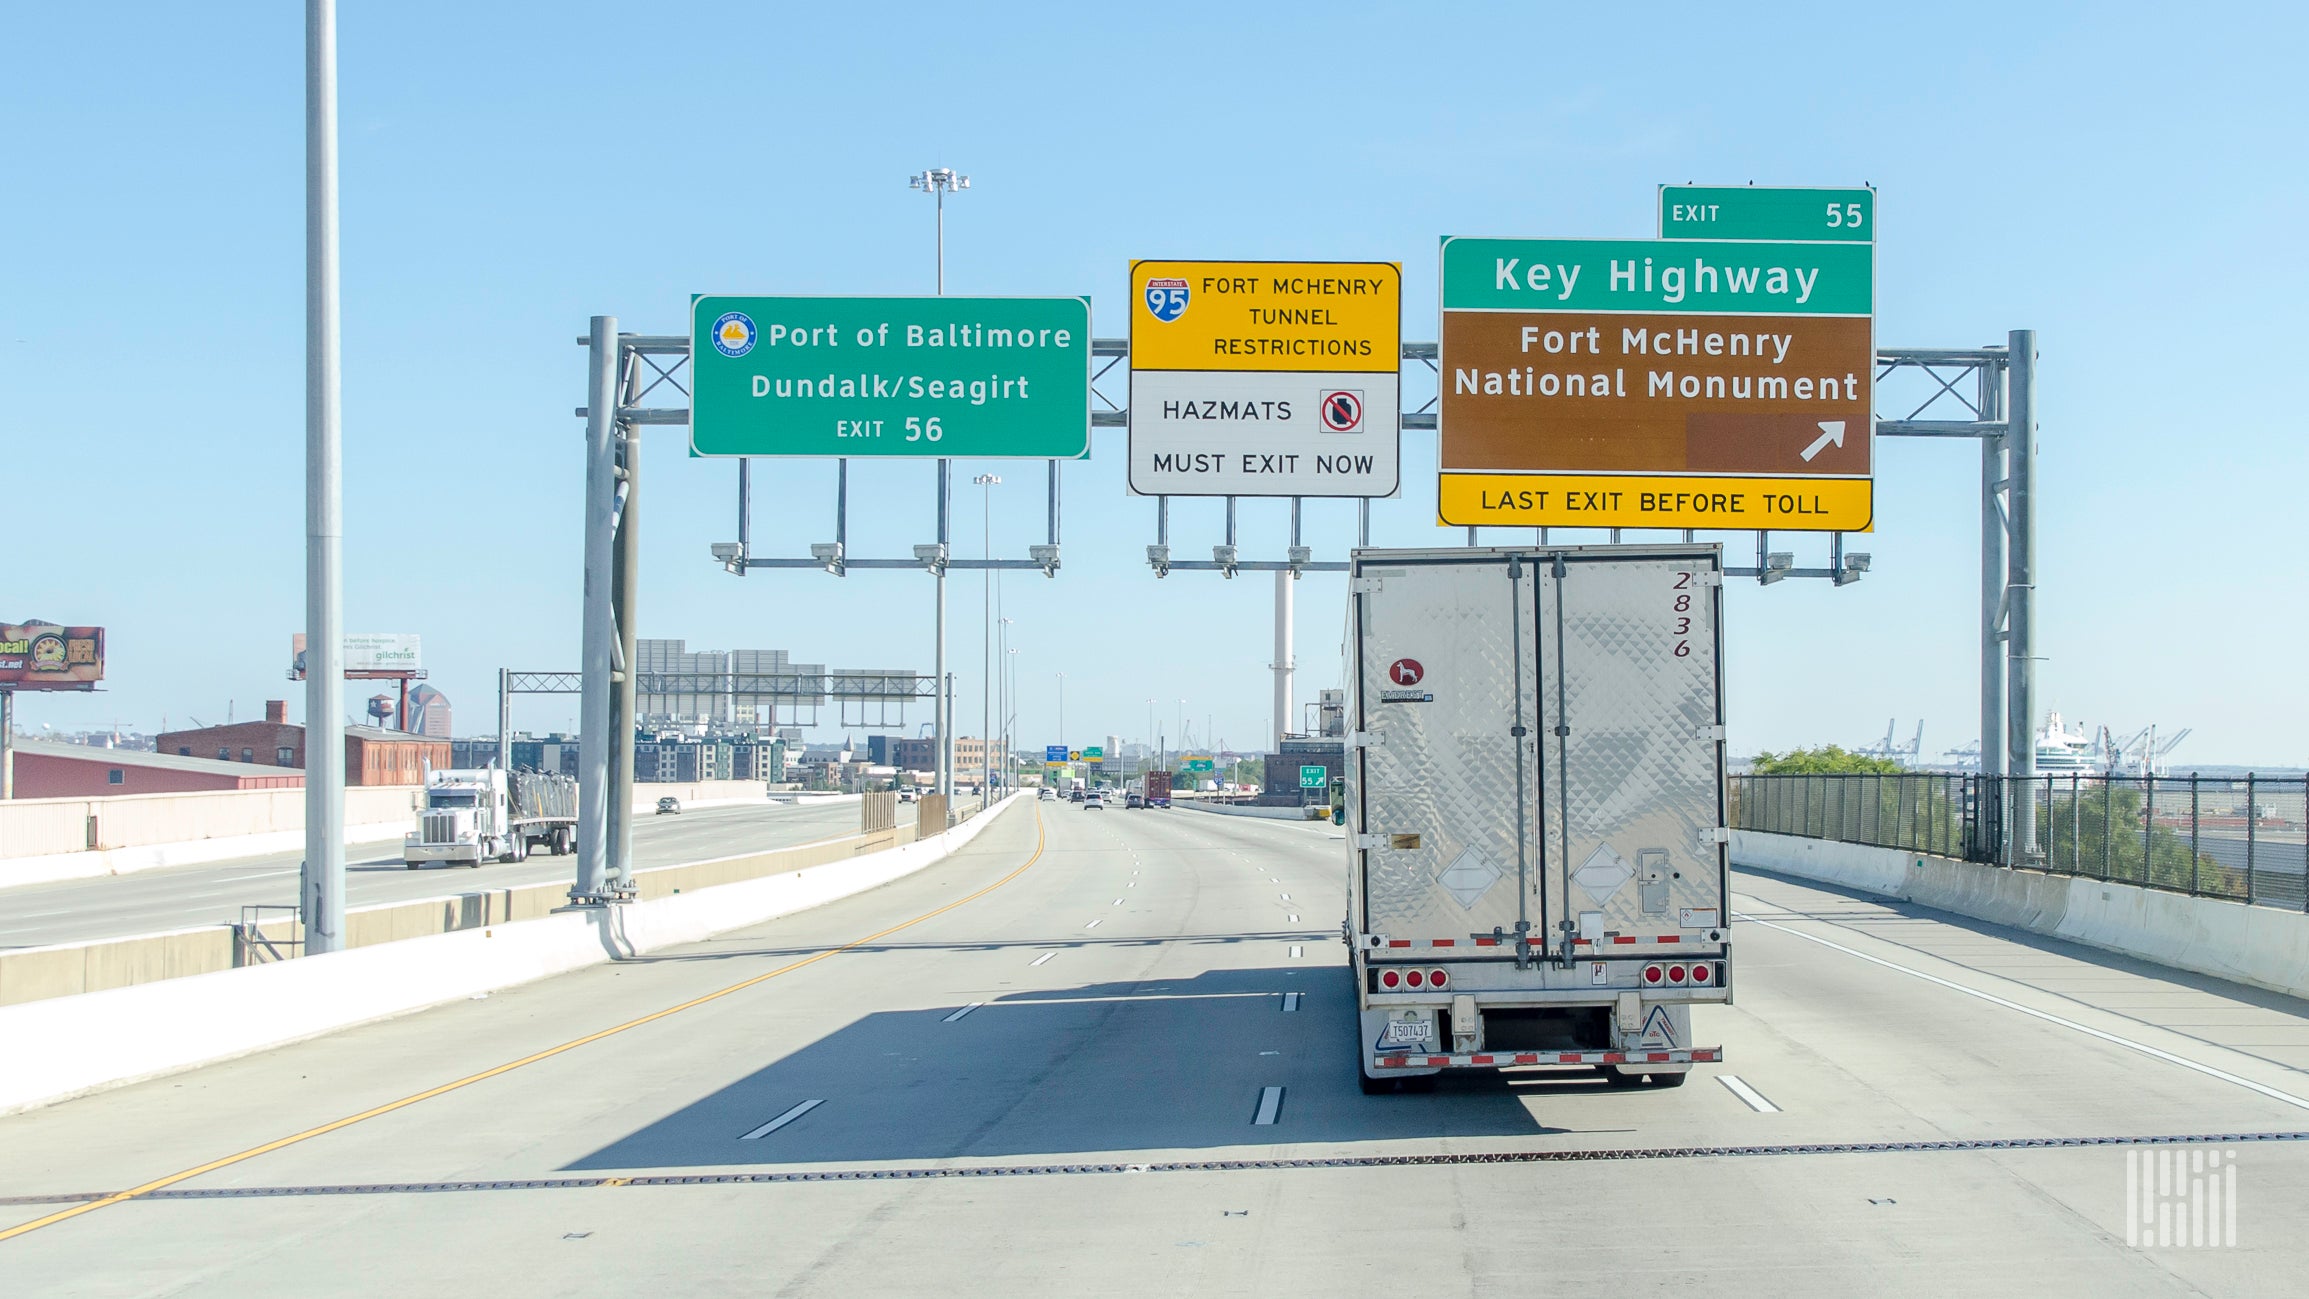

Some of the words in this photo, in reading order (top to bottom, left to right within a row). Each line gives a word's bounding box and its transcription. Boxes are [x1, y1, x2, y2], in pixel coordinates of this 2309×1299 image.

[1672, 205, 1720, 222] EXIT
[1826, 203, 1863, 228] 55
[1203, 278, 1259, 294] FORT
[1274, 278, 1384, 295] MCHENRY
[1495, 257, 1582, 301] Key
[1610, 257, 1819, 304] Highway
[1148, 289, 1186, 315] 95
[721, 314, 738, 323] PORT
[739, 315, 748, 323] OF
[1250, 309, 1338, 325] TUNNEL
[770, 324, 838, 347] Port
[856, 323, 888, 347] of
[906, 324, 1072, 348] Baltimore
[1521, 326, 1601, 354] Fort
[1622, 328, 1793, 364] McHenry
[716, 341, 754, 355] BALTIMORE
[1214, 339, 1372, 356] RESTRICTIONS
[752, 375, 1030, 406] Dundalk/Seagirt
[1455, 367, 1626, 397] National
[1648, 371, 1859, 401] Monument
[1163, 400, 1292, 420] HAZMATS
[837, 420, 884, 438] EXIT
[904, 417, 944, 442] 56
[1154, 454, 1225, 473] MUST
[1242, 454, 1299, 474] EXIT
[1316, 455, 1374, 474] NOW
[1481, 490, 1550, 510] LAST
[1566, 491, 1624, 511] EXIT
[1640, 492, 1745, 513] BEFORE
[1762, 494, 1829, 514] TOLL
[1672, 572, 1691, 658] 2836
[376, 648, 415, 661] gilchrist
[1381, 690, 1424, 700] EVEREST
[1302, 777, 1313, 785] 55
[1393, 1025, 1428, 1037] T507437
